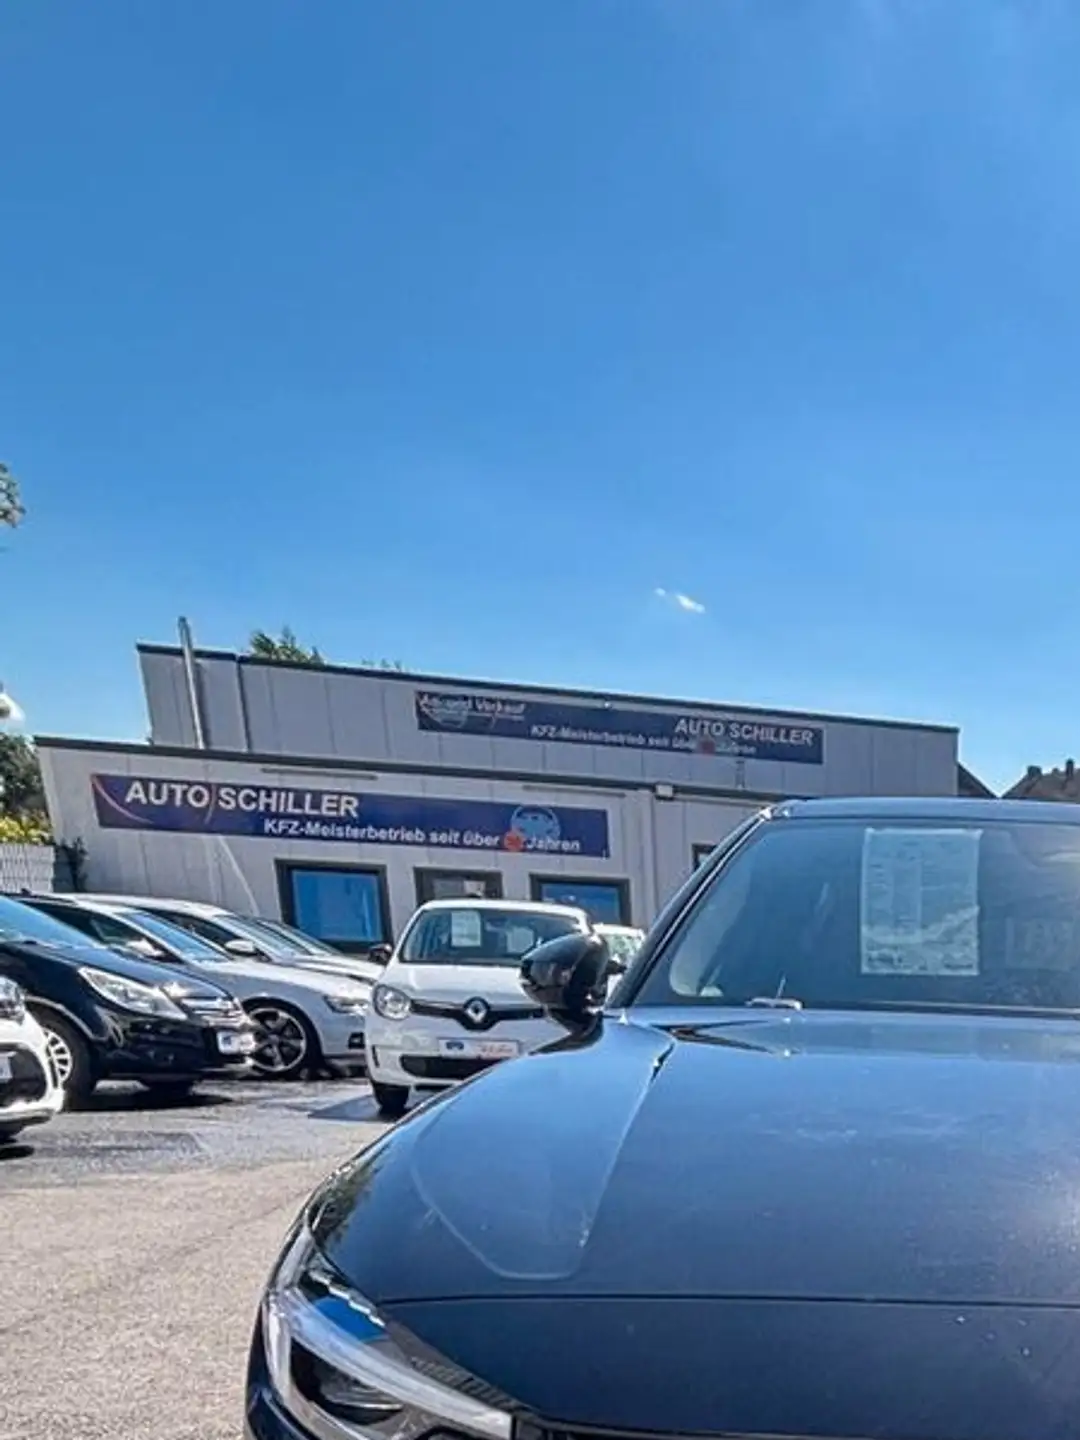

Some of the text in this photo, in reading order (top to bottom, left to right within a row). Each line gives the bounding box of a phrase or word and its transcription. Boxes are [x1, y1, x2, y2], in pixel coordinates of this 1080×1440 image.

[675, 717, 725, 736] AUTO
[729, 721, 815, 747] SCHILLER
[125, 780, 360, 818] AUTO SCHILLER
[263, 817, 426, 842] KFZ-Meisterbetrieb
[429, 829, 460, 845] seit
[463, 829, 500, 847] über
[526, 835, 581, 851] Jahren
